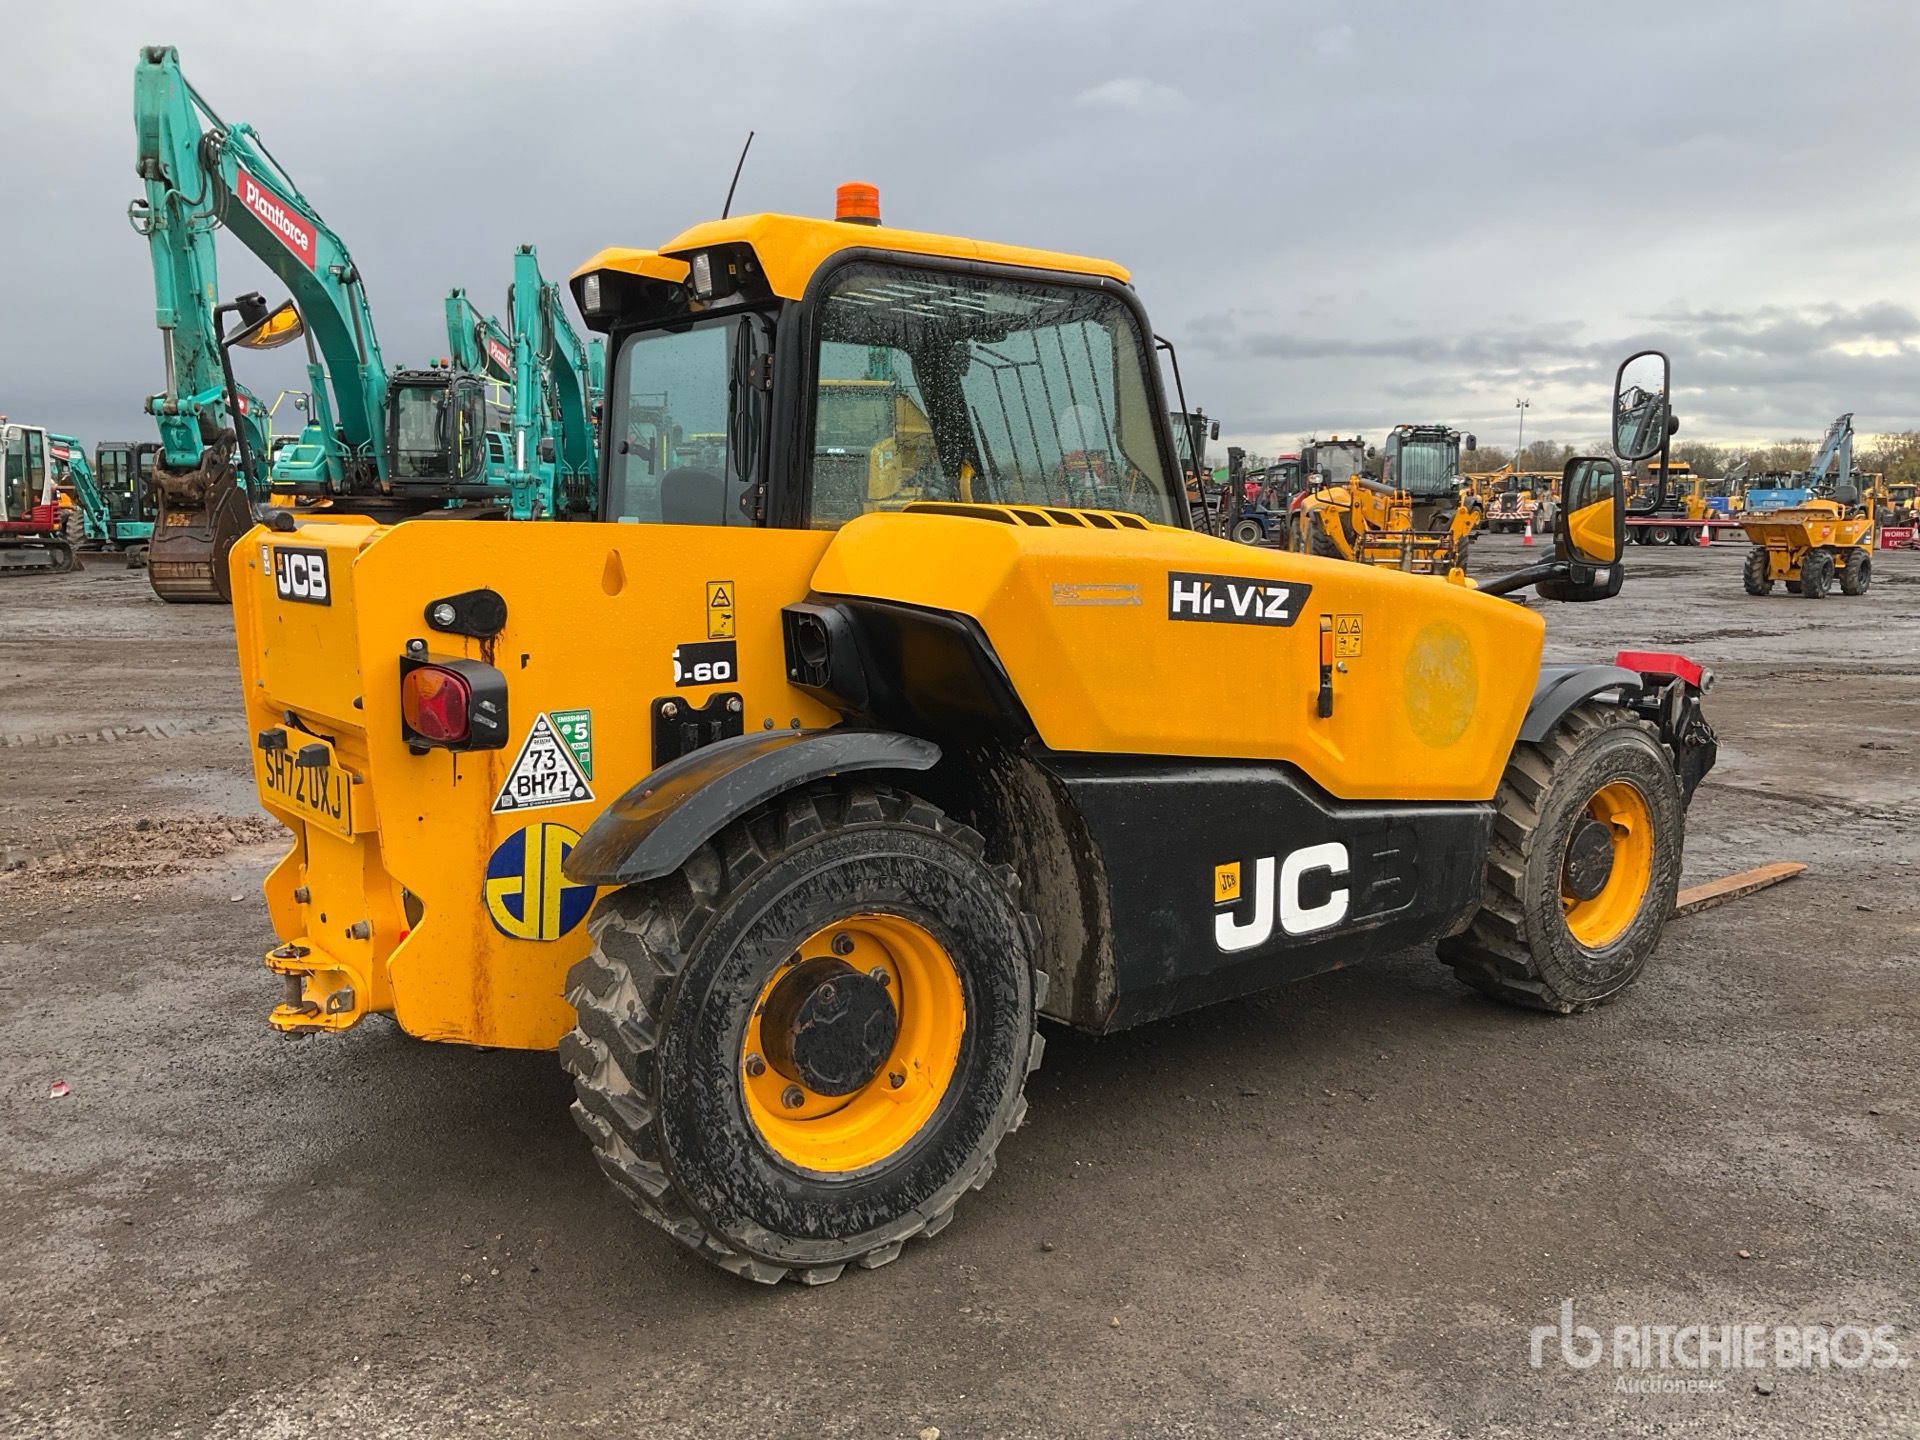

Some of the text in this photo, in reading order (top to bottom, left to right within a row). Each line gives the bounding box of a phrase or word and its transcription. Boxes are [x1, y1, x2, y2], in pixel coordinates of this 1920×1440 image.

[246, 180, 309, 251] Plantforce
[1884, 530, 1911, 538] WORKS
[277, 553, 327, 599] JCB
[574, 723, 588, 740] 5
[530, 749, 556, 772] 73
[1221, 874, 1236, 891] JCB
